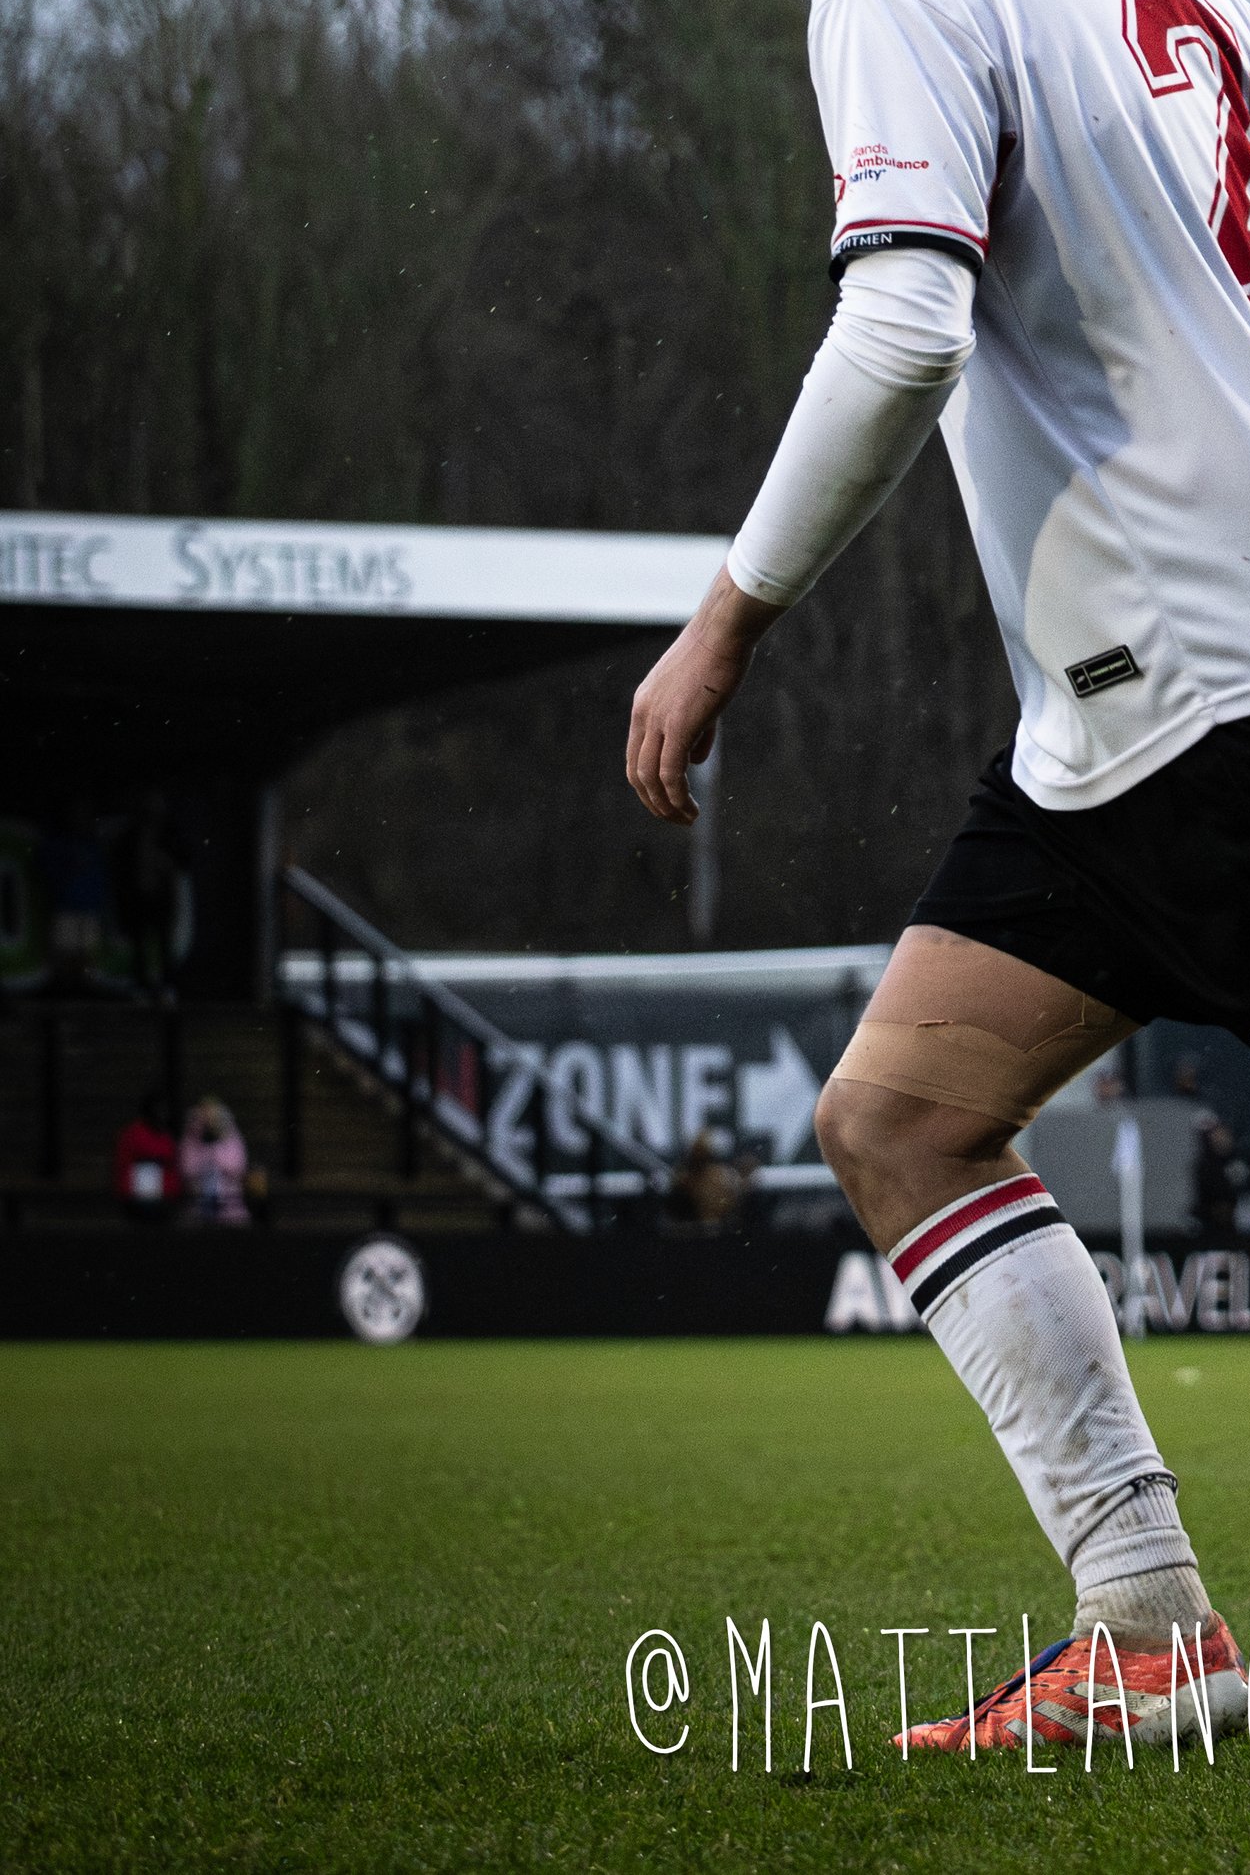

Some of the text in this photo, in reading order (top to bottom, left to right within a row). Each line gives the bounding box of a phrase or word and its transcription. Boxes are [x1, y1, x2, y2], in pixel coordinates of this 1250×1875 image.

[849, 168, 884, 182] arity
[855, 155, 930, 170] Ambulance
[172, 523, 413, 603] SYSTEMS
[486, 1039, 735, 1156] ZONE
